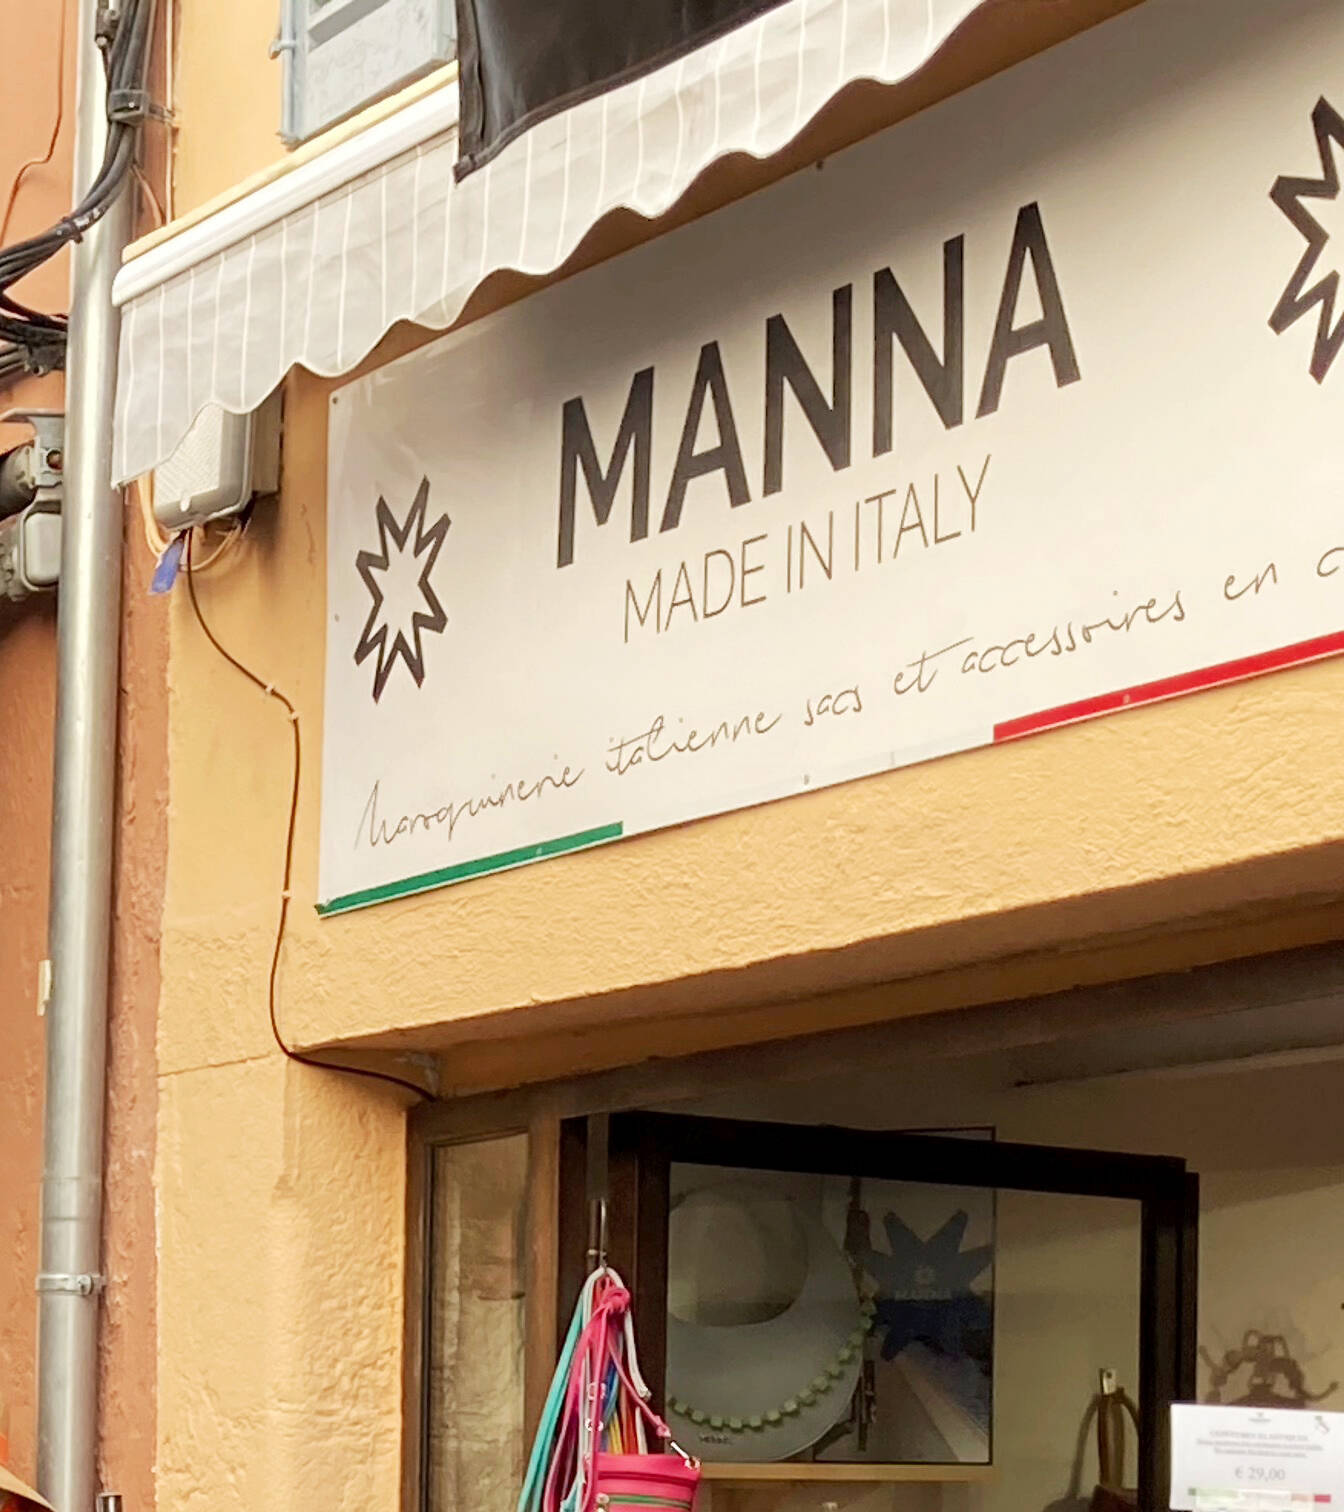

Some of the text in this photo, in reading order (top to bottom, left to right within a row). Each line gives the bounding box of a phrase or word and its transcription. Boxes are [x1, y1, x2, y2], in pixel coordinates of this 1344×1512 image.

[555, 200, 1082, 570] MANNA
[622, 453, 994, 644] MADE IN ITALY
[604, 713, 783, 776] italienne
[804, 685, 863, 727] sacs
[893, 636, 976, 696] et
[960, 588, 1186, 676] accessoires
[1223, 561, 1279, 601] en
